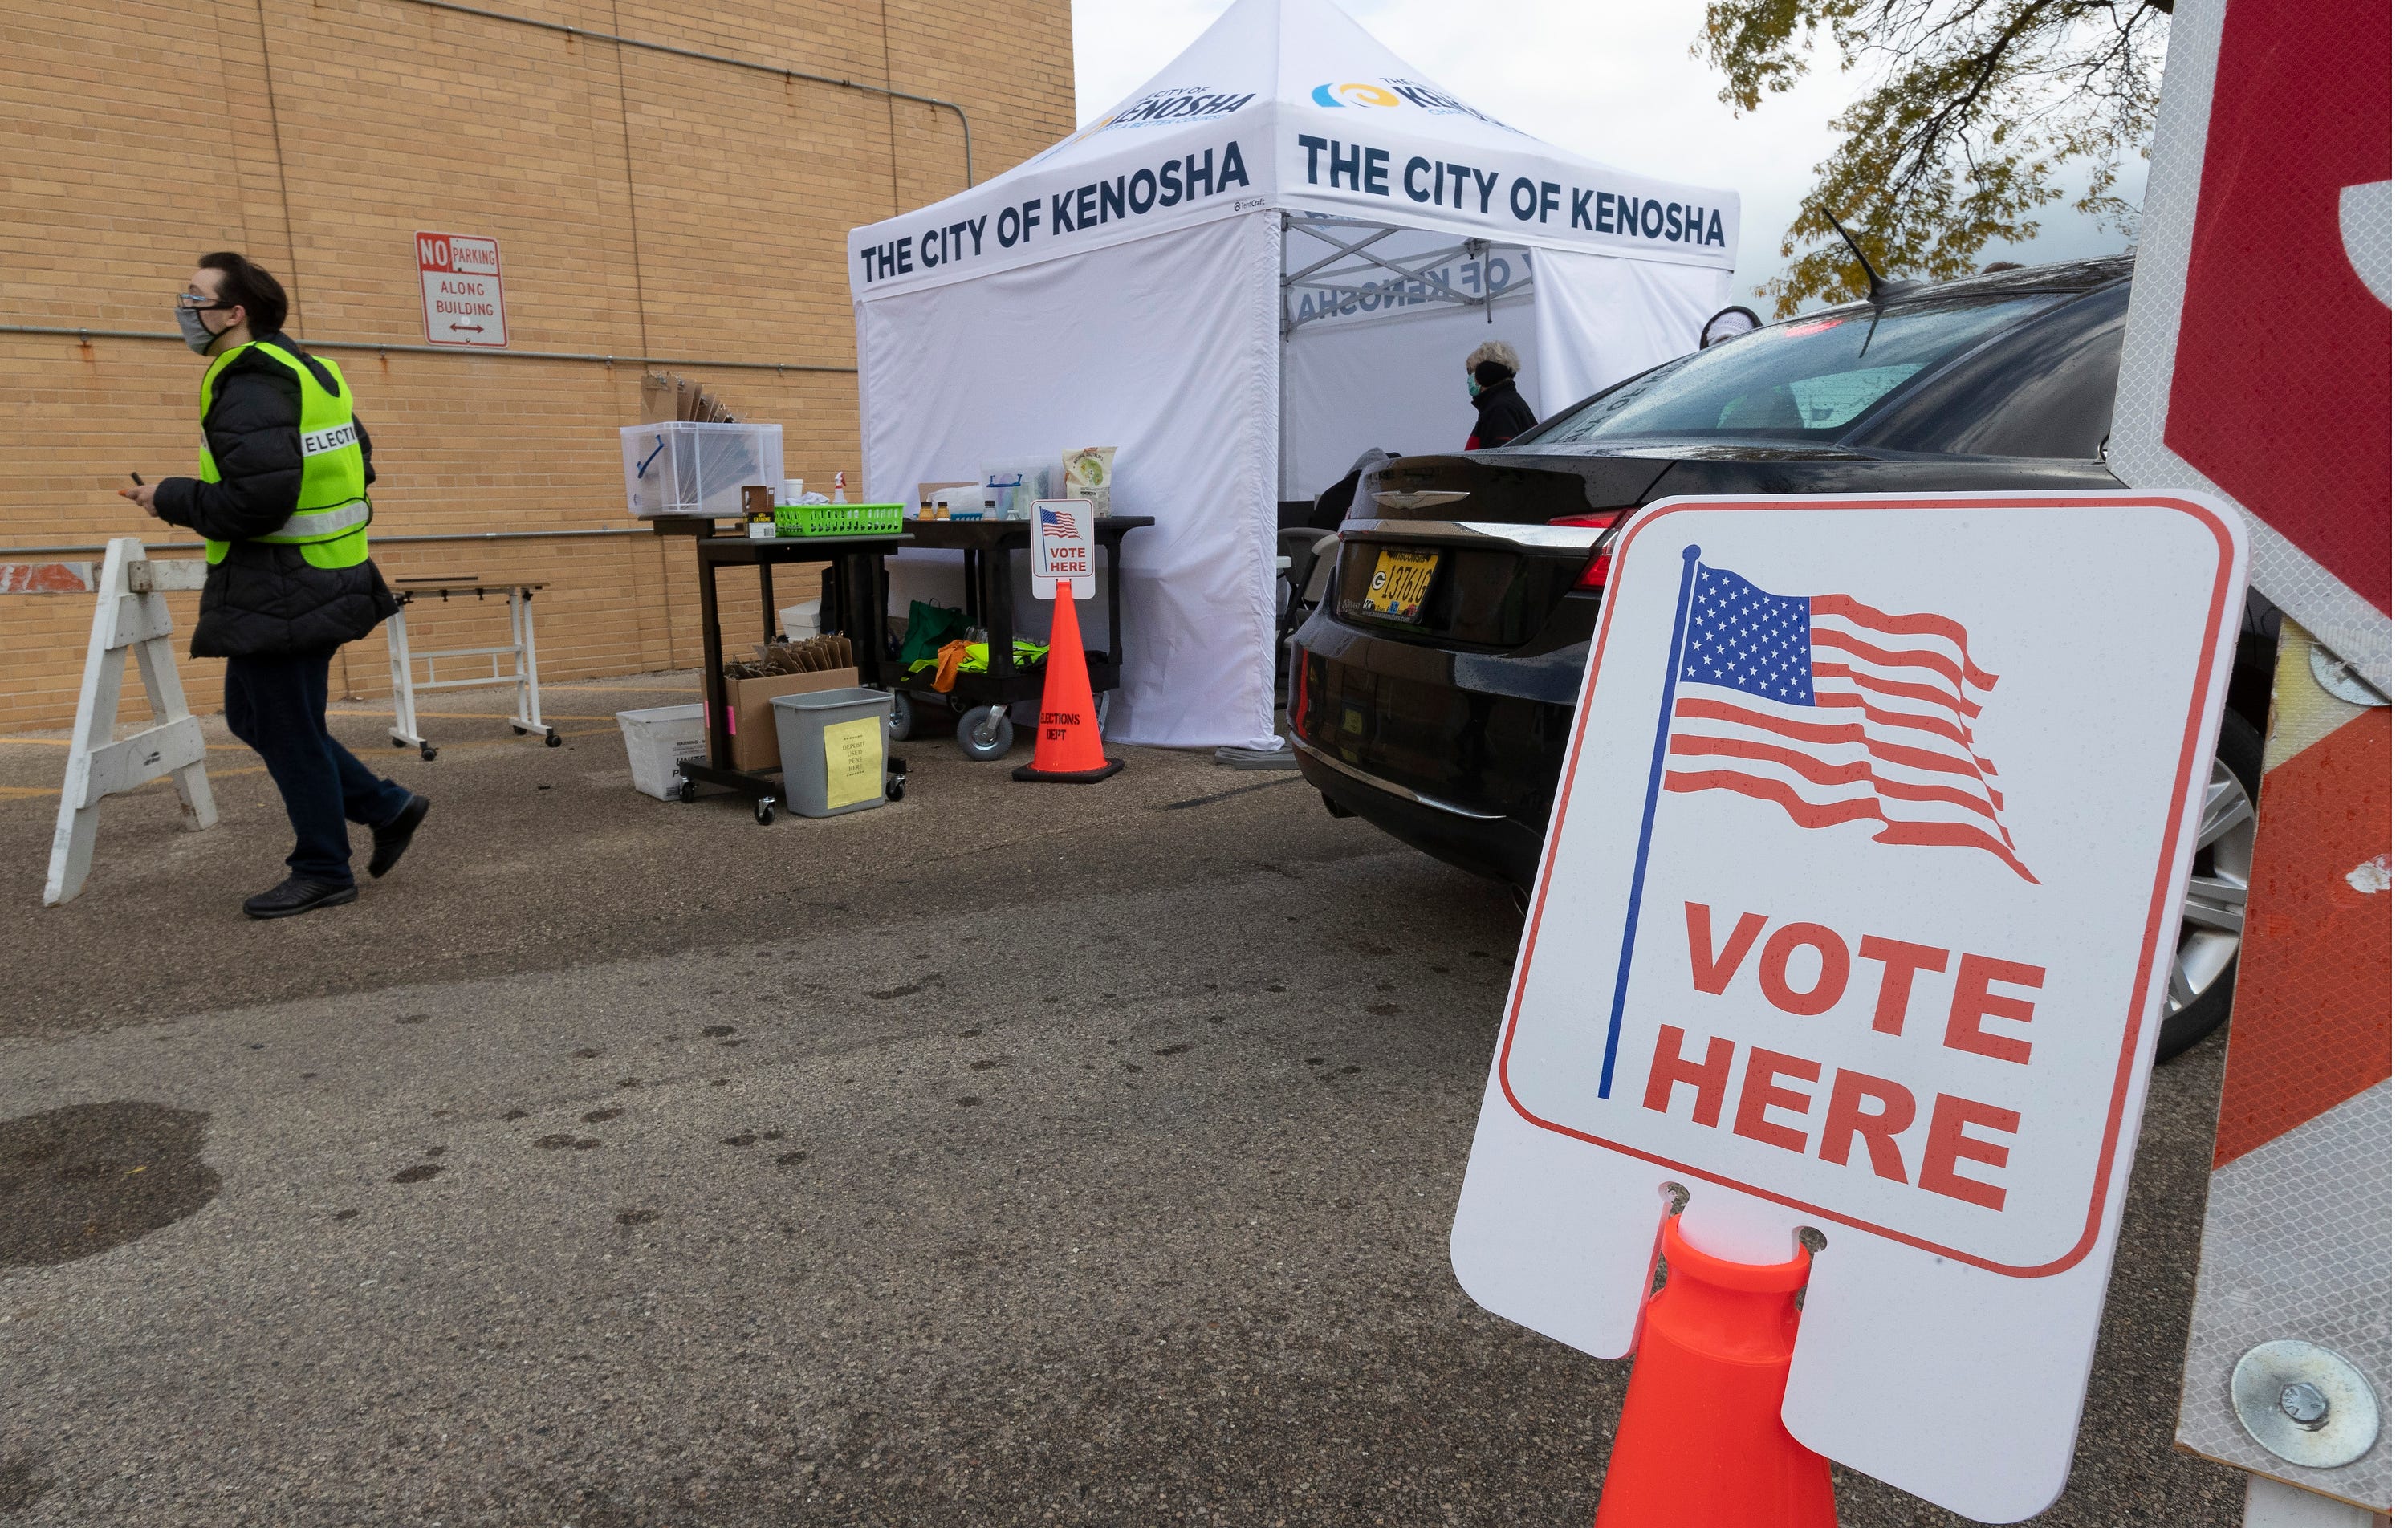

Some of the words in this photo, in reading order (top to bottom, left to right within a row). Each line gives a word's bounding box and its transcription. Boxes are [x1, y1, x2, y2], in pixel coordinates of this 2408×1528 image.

[1154, 88, 1188, 98] CITY
[1187, 86, 1210, 95] OF
[1298, 134, 1390, 196] THE
[1403, 156, 1499, 214] CITY
[1510, 177, 1561, 223] OF
[1572, 189, 1726, 247] KENOSHA
[861, 237, 913, 282] THE
[921, 215, 987, 268] CITY
[997, 198, 1041, 248] OF
[1052, 140, 1250, 235] KENOSHA
[420, 238, 448, 266] NO
[453, 247, 495, 265] PARKING
[441, 281, 485, 295] ALONG
[437, 300, 494, 315] BUILDING
[305, 427, 356, 453] ELECTI
[1050, 547, 1085, 558] VOTE
[1051, 562, 1086, 571] HERE
[1381, 565, 1432, 603] 13761G
[1047, 729, 1066, 740] DEPT
[842, 742, 864, 750] DEPOSIT
[848, 764, 862, 772] HERE
[1684, 900, 2046, 1065] VOTE
[1642, 1023, 2021, 1212] HERE
